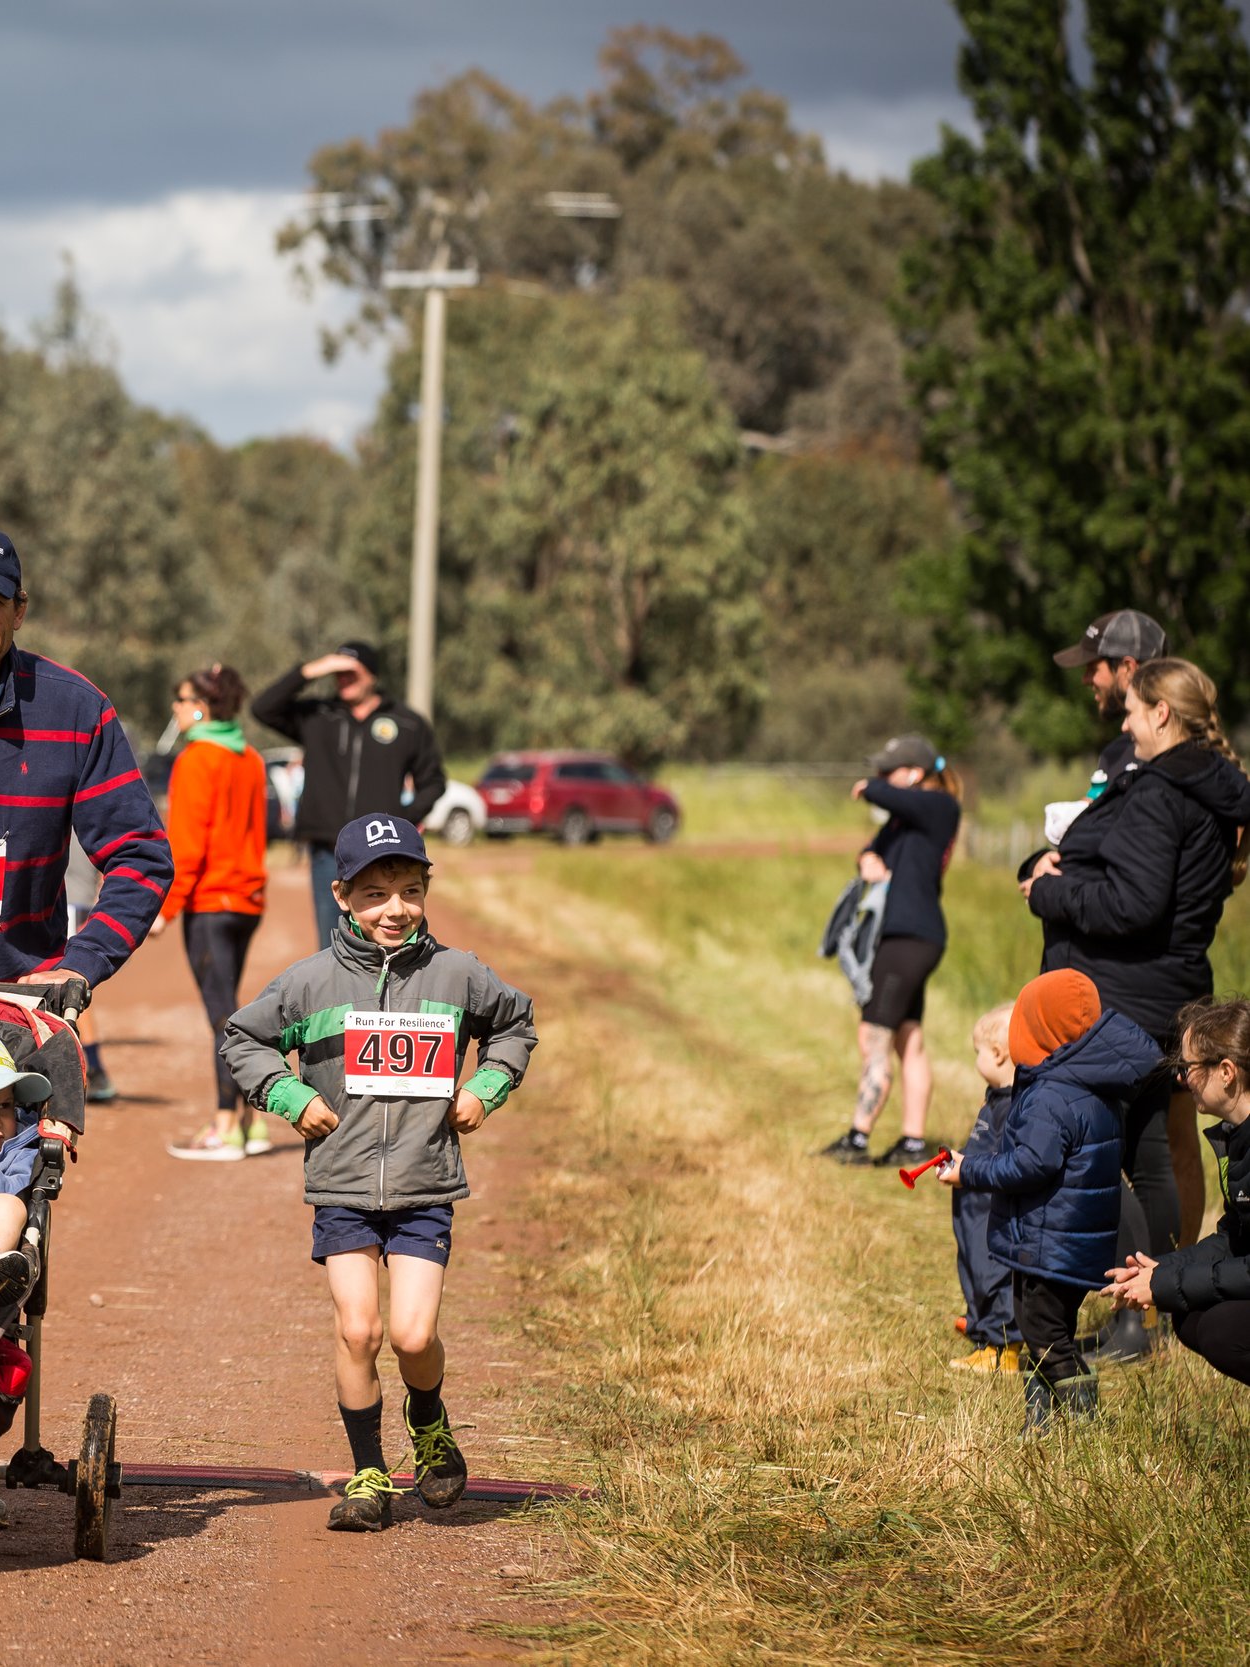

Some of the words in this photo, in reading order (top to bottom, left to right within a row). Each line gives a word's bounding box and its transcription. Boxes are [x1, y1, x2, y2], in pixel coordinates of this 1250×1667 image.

[355, 1017, 374, 1026] Run
[379, 1018, 395, 1027] For
[400, 1018, 445, 1028] Resilience
[357, 1032, 443, 1075] 497
